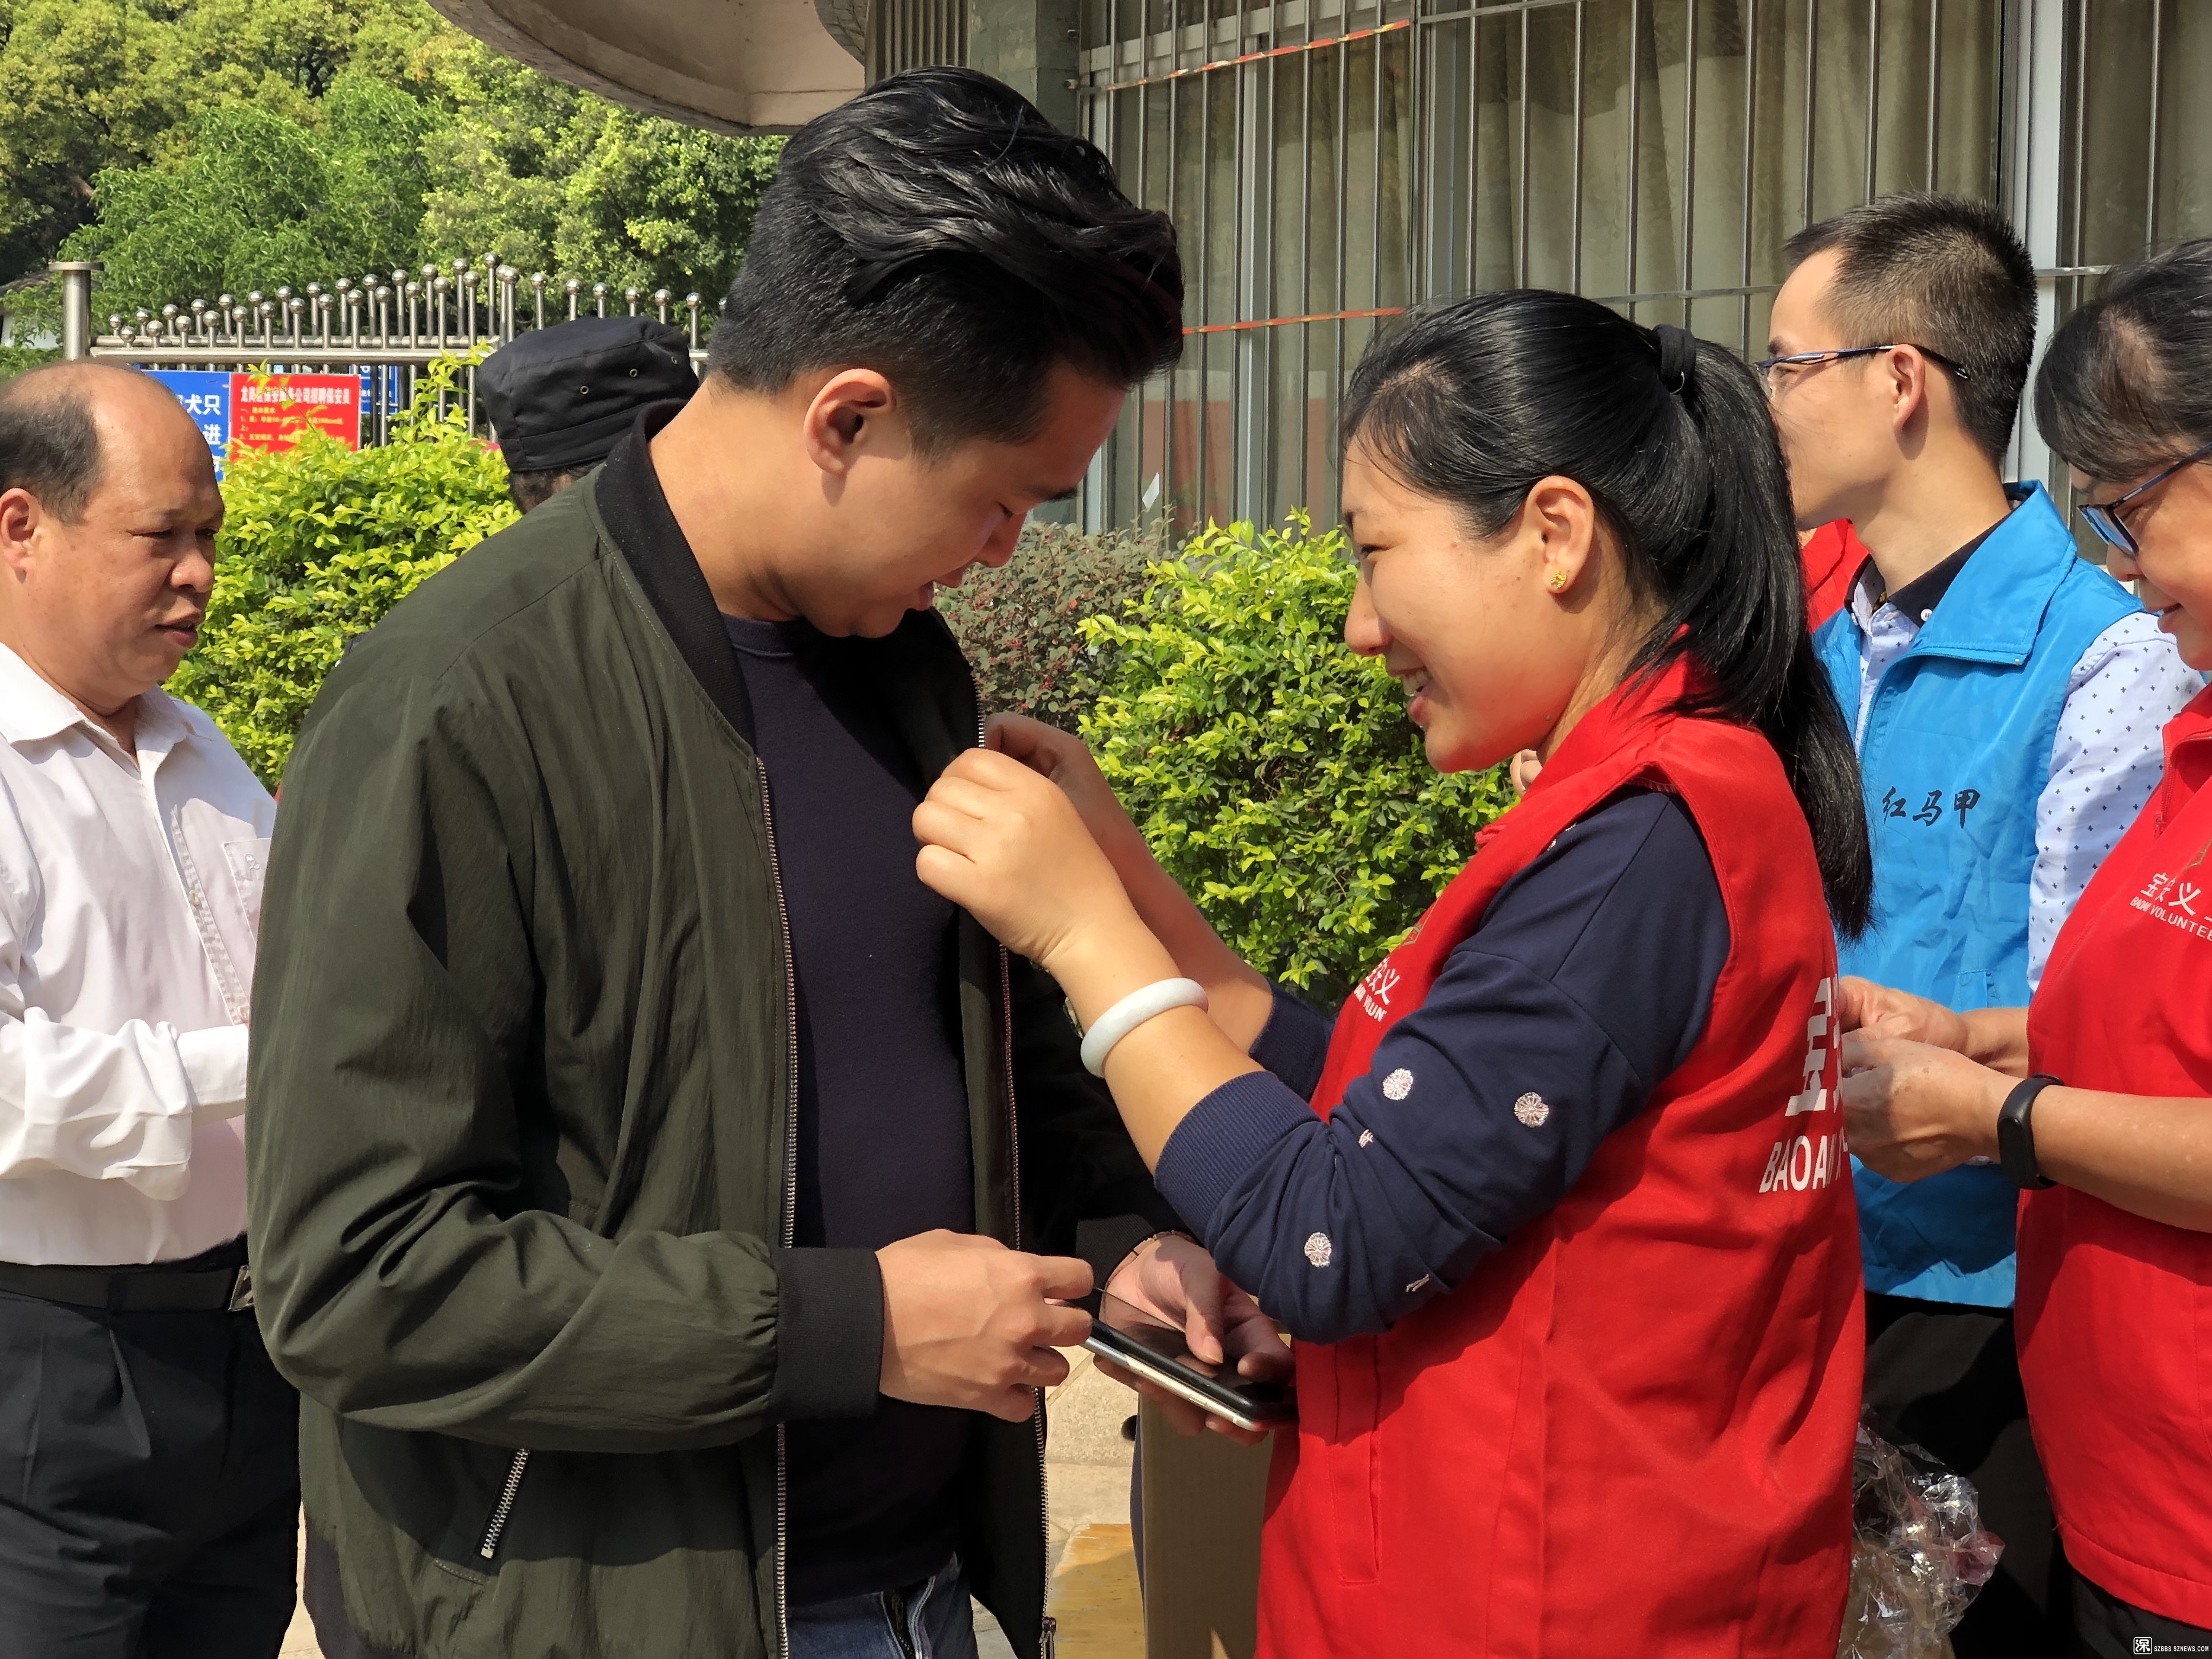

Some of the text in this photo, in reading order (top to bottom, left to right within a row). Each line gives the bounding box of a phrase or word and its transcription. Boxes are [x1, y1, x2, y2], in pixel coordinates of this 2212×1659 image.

[177, 394, 221, 415] 犬只
[1882, 785, 1981, 829] 红马甲
